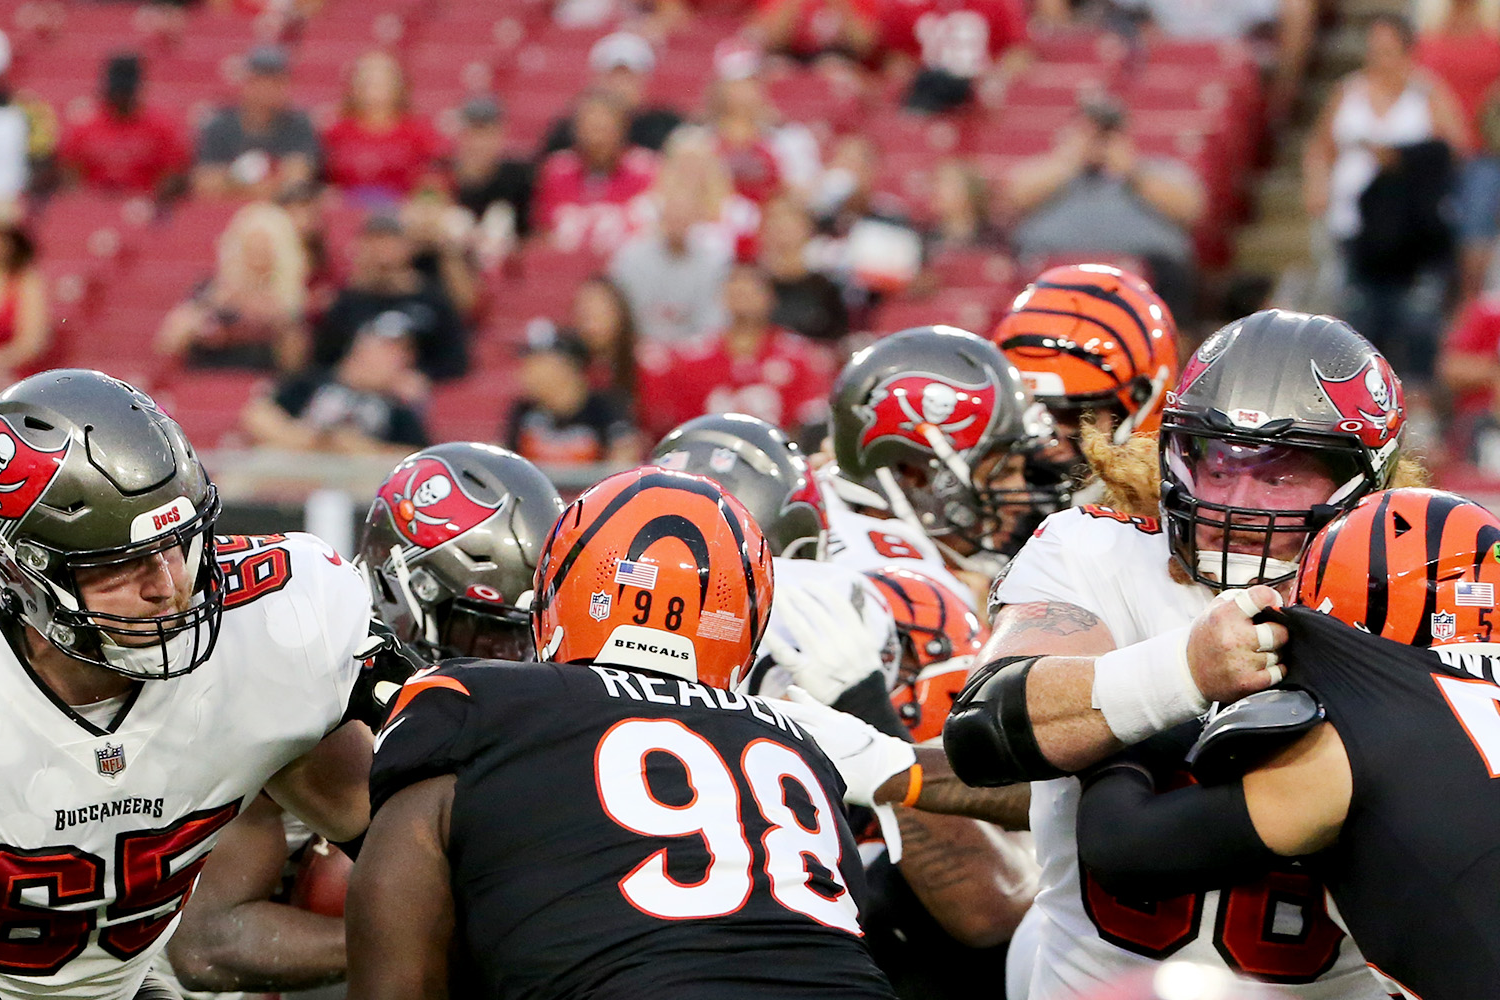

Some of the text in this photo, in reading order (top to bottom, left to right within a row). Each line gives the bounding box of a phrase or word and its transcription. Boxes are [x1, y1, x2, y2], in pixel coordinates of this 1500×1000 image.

[593, 605, 606, 617] NFL
[1436, 624, 1453, 636] NFL
[614, 639, 690, 661] BENGALS
[102, 757, 123, 772] NFL
[54, 797, 165, 832] BUCCANEERS
[593, 717, 865, 938] 98
